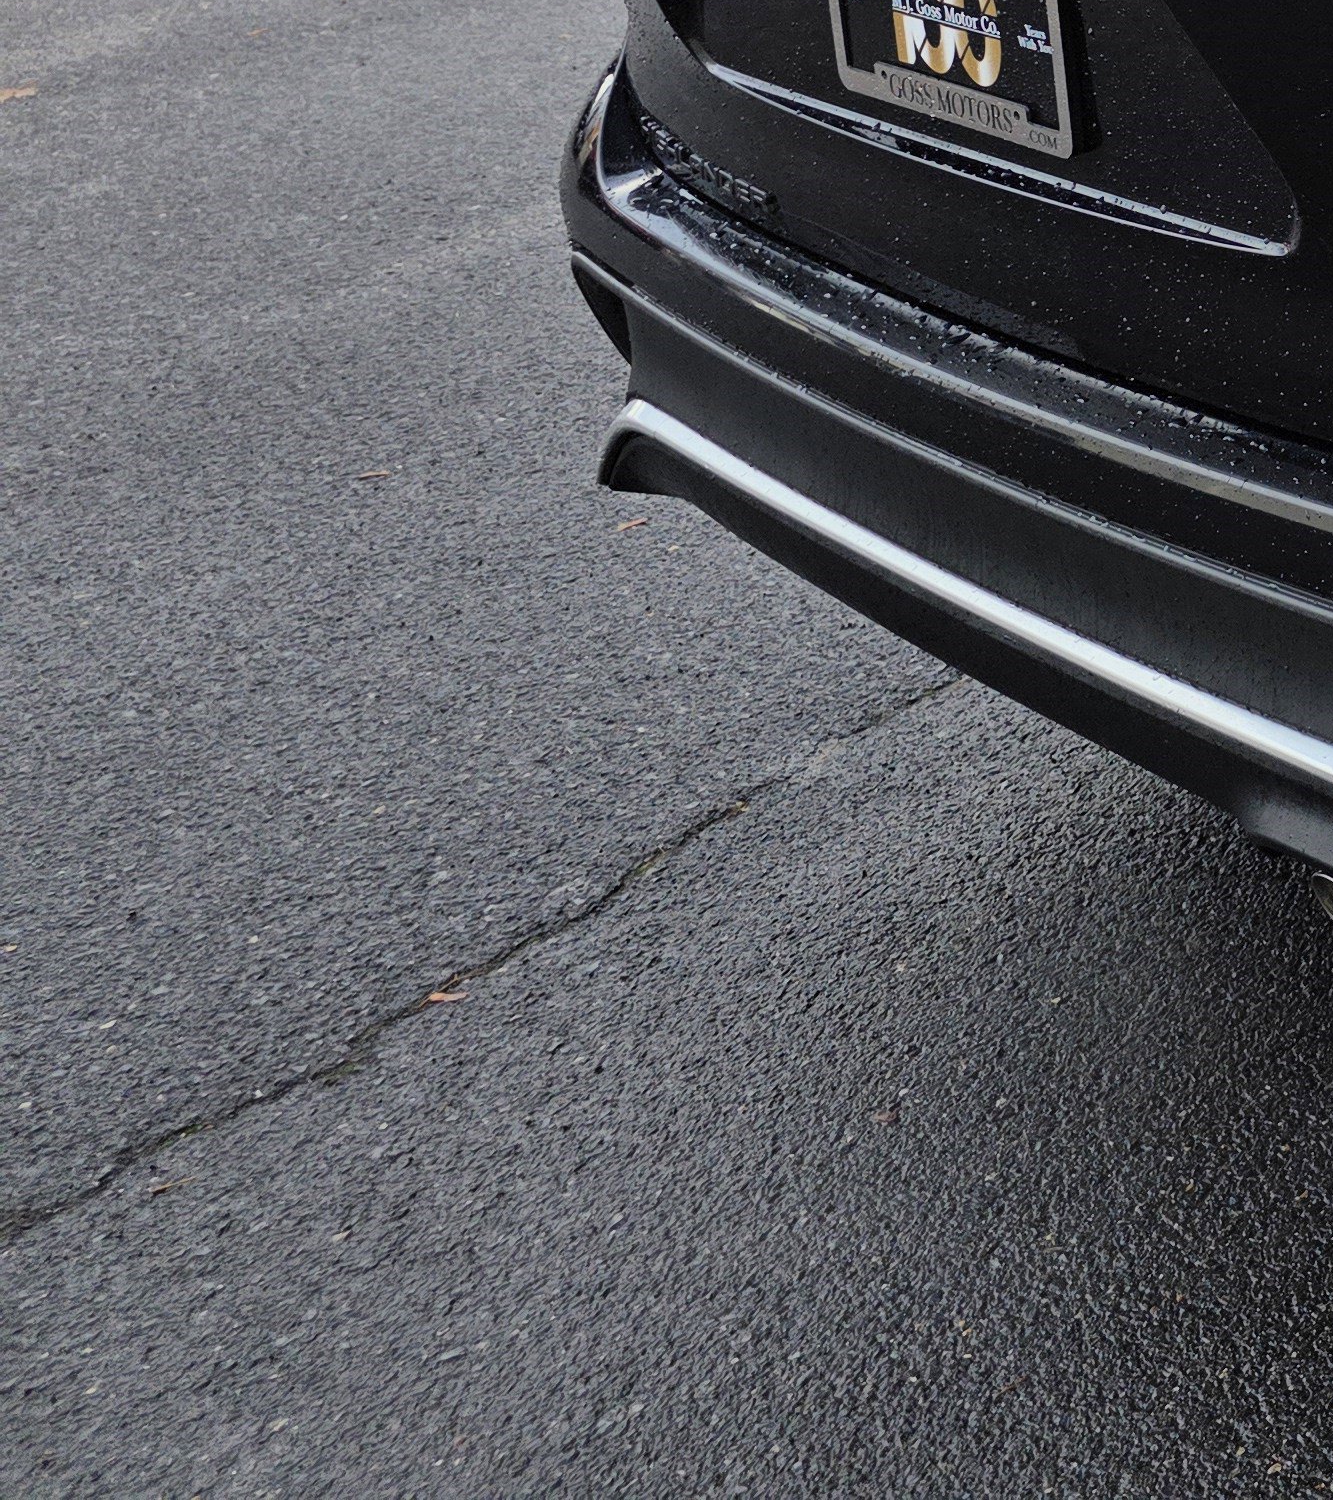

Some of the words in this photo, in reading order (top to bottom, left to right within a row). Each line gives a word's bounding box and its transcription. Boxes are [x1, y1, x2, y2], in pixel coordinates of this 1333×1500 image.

[943, 5, 979, 30] Motor
[980, 15, 1001, 36] Co.
[1023, 23, 1047, 41] Years
[889, 72, 933, 109] GOSS
[937, 85, 1013, 134] MOTORS
